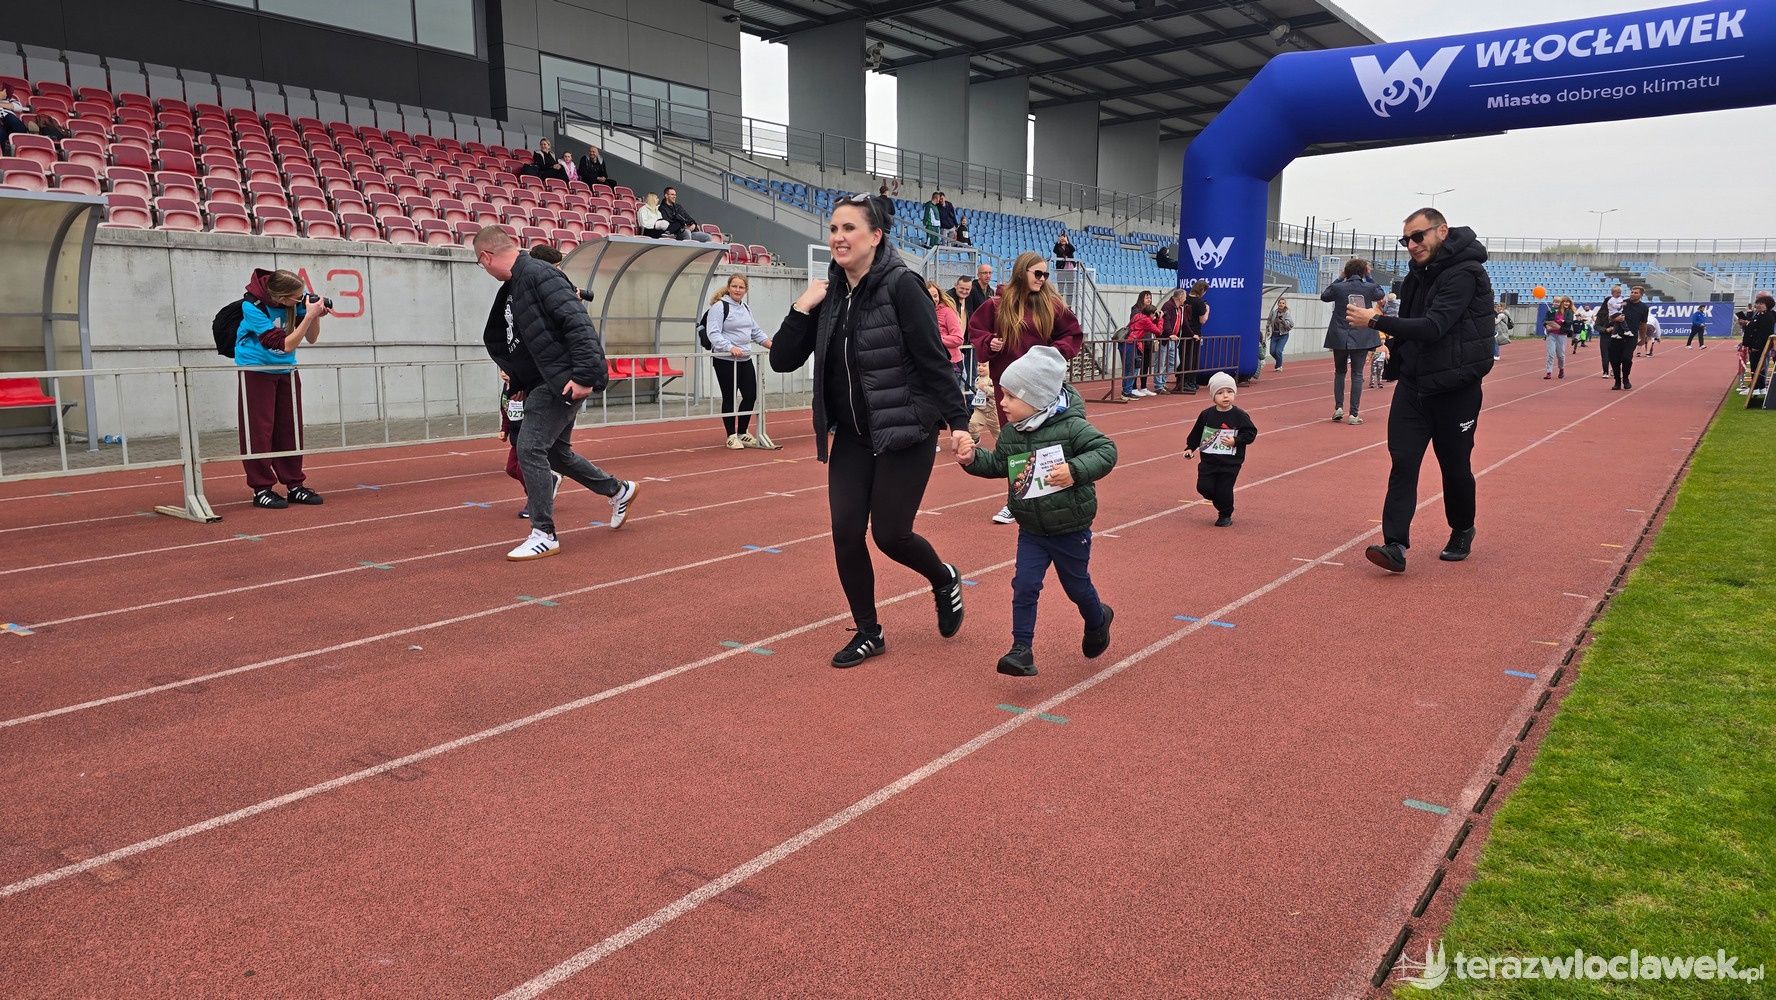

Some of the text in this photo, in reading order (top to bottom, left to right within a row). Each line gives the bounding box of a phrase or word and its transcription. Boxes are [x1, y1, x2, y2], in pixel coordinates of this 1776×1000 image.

[1476, 9, 1746, 68] WŁOCŁAWEK
[1487, 76, 1720, 109] Miasto dobrego klimatu
